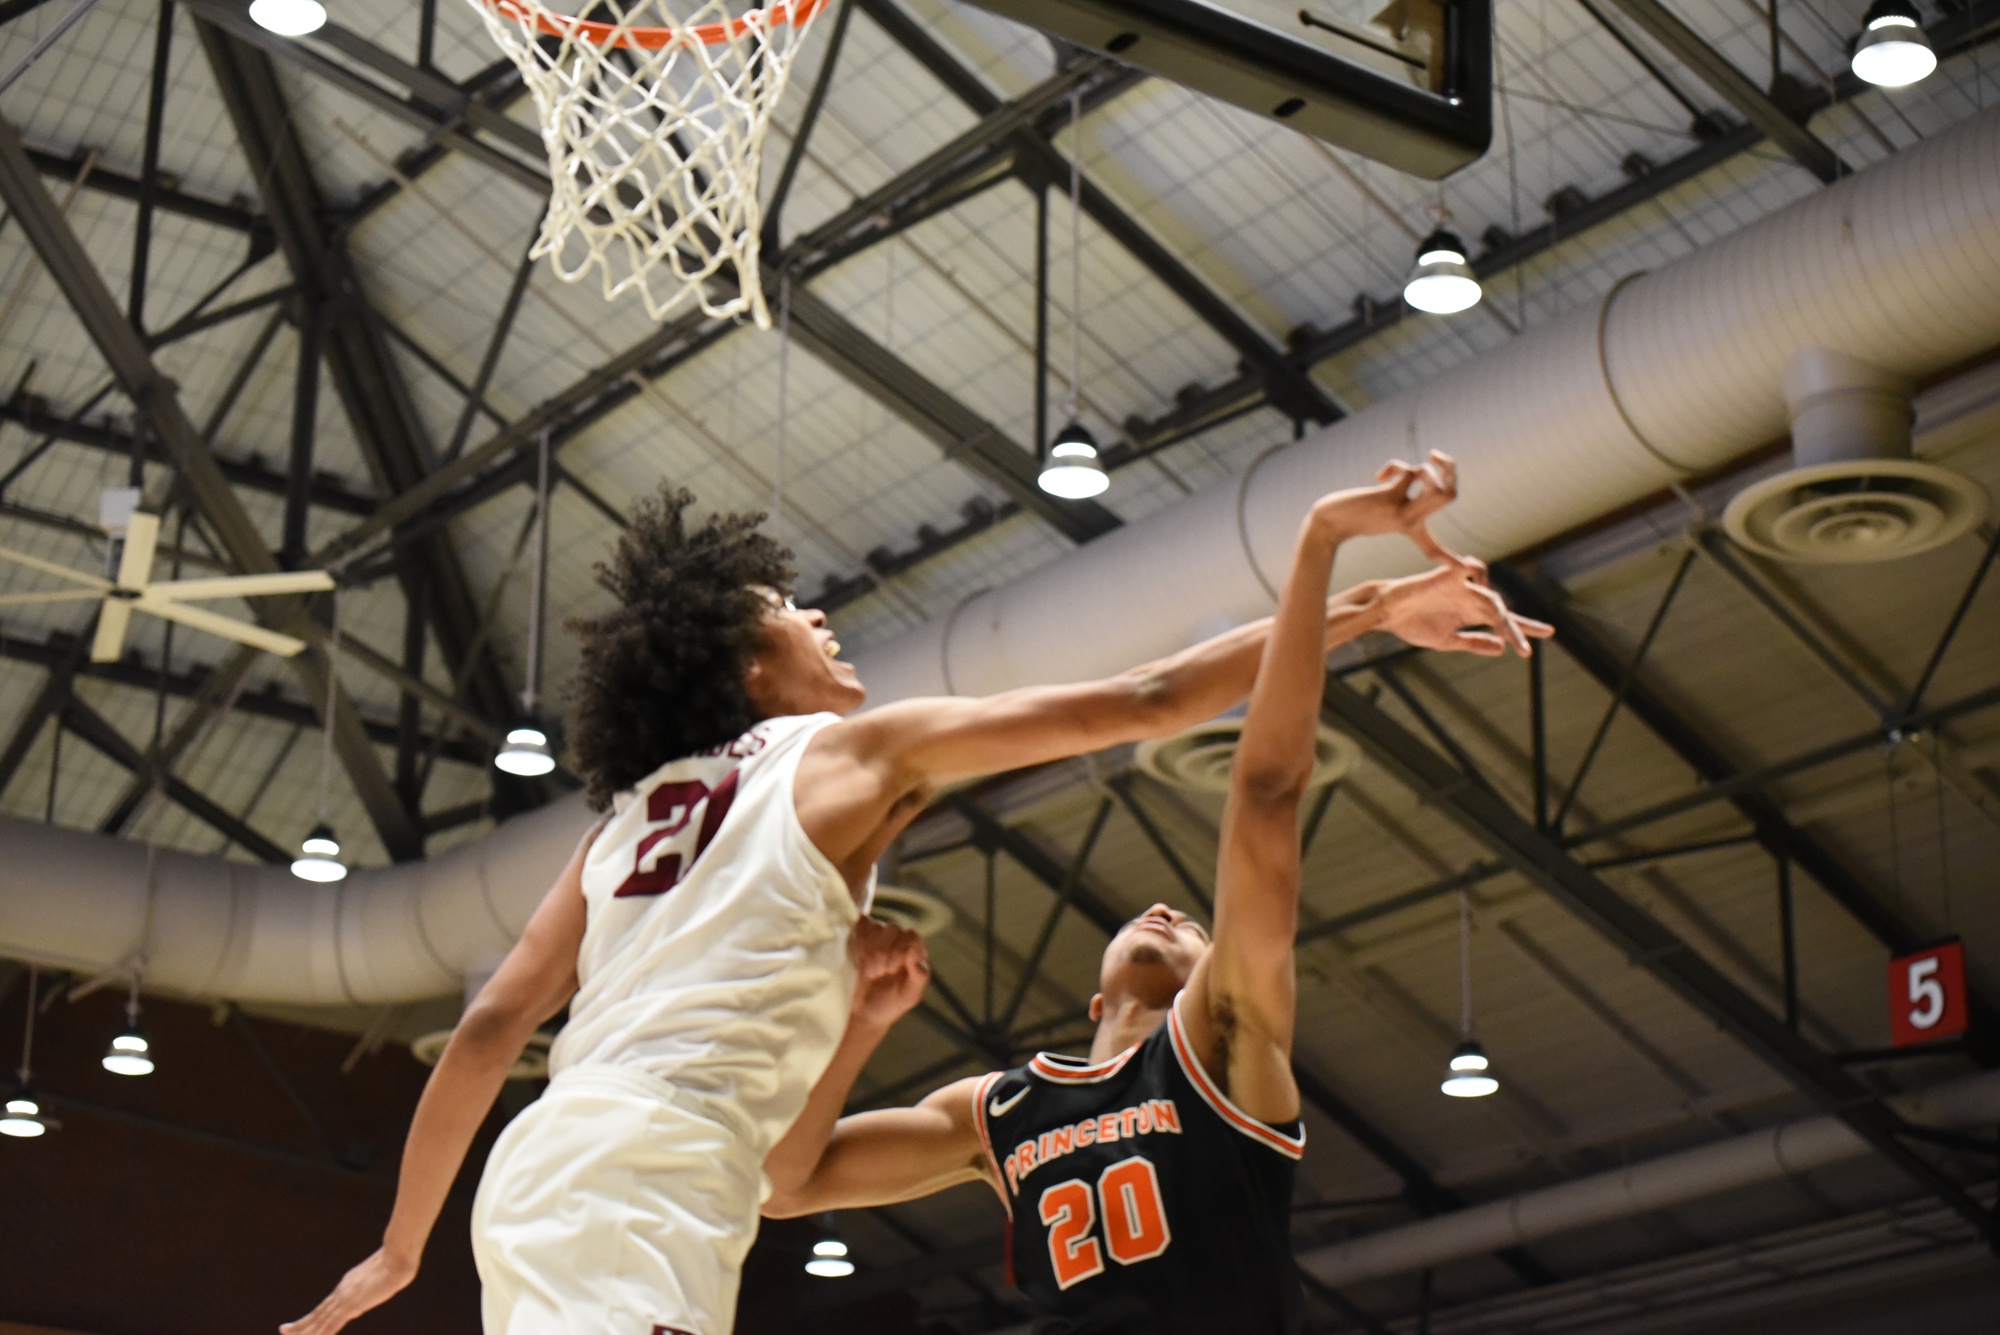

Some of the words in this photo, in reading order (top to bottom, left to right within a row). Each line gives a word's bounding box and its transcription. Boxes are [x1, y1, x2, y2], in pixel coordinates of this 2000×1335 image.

[1908, 956, 1944, 1030] 5
[1004, 1099, 1183, 1197] PRINCETON
[1038, 1155, 1172, 1291] 20
